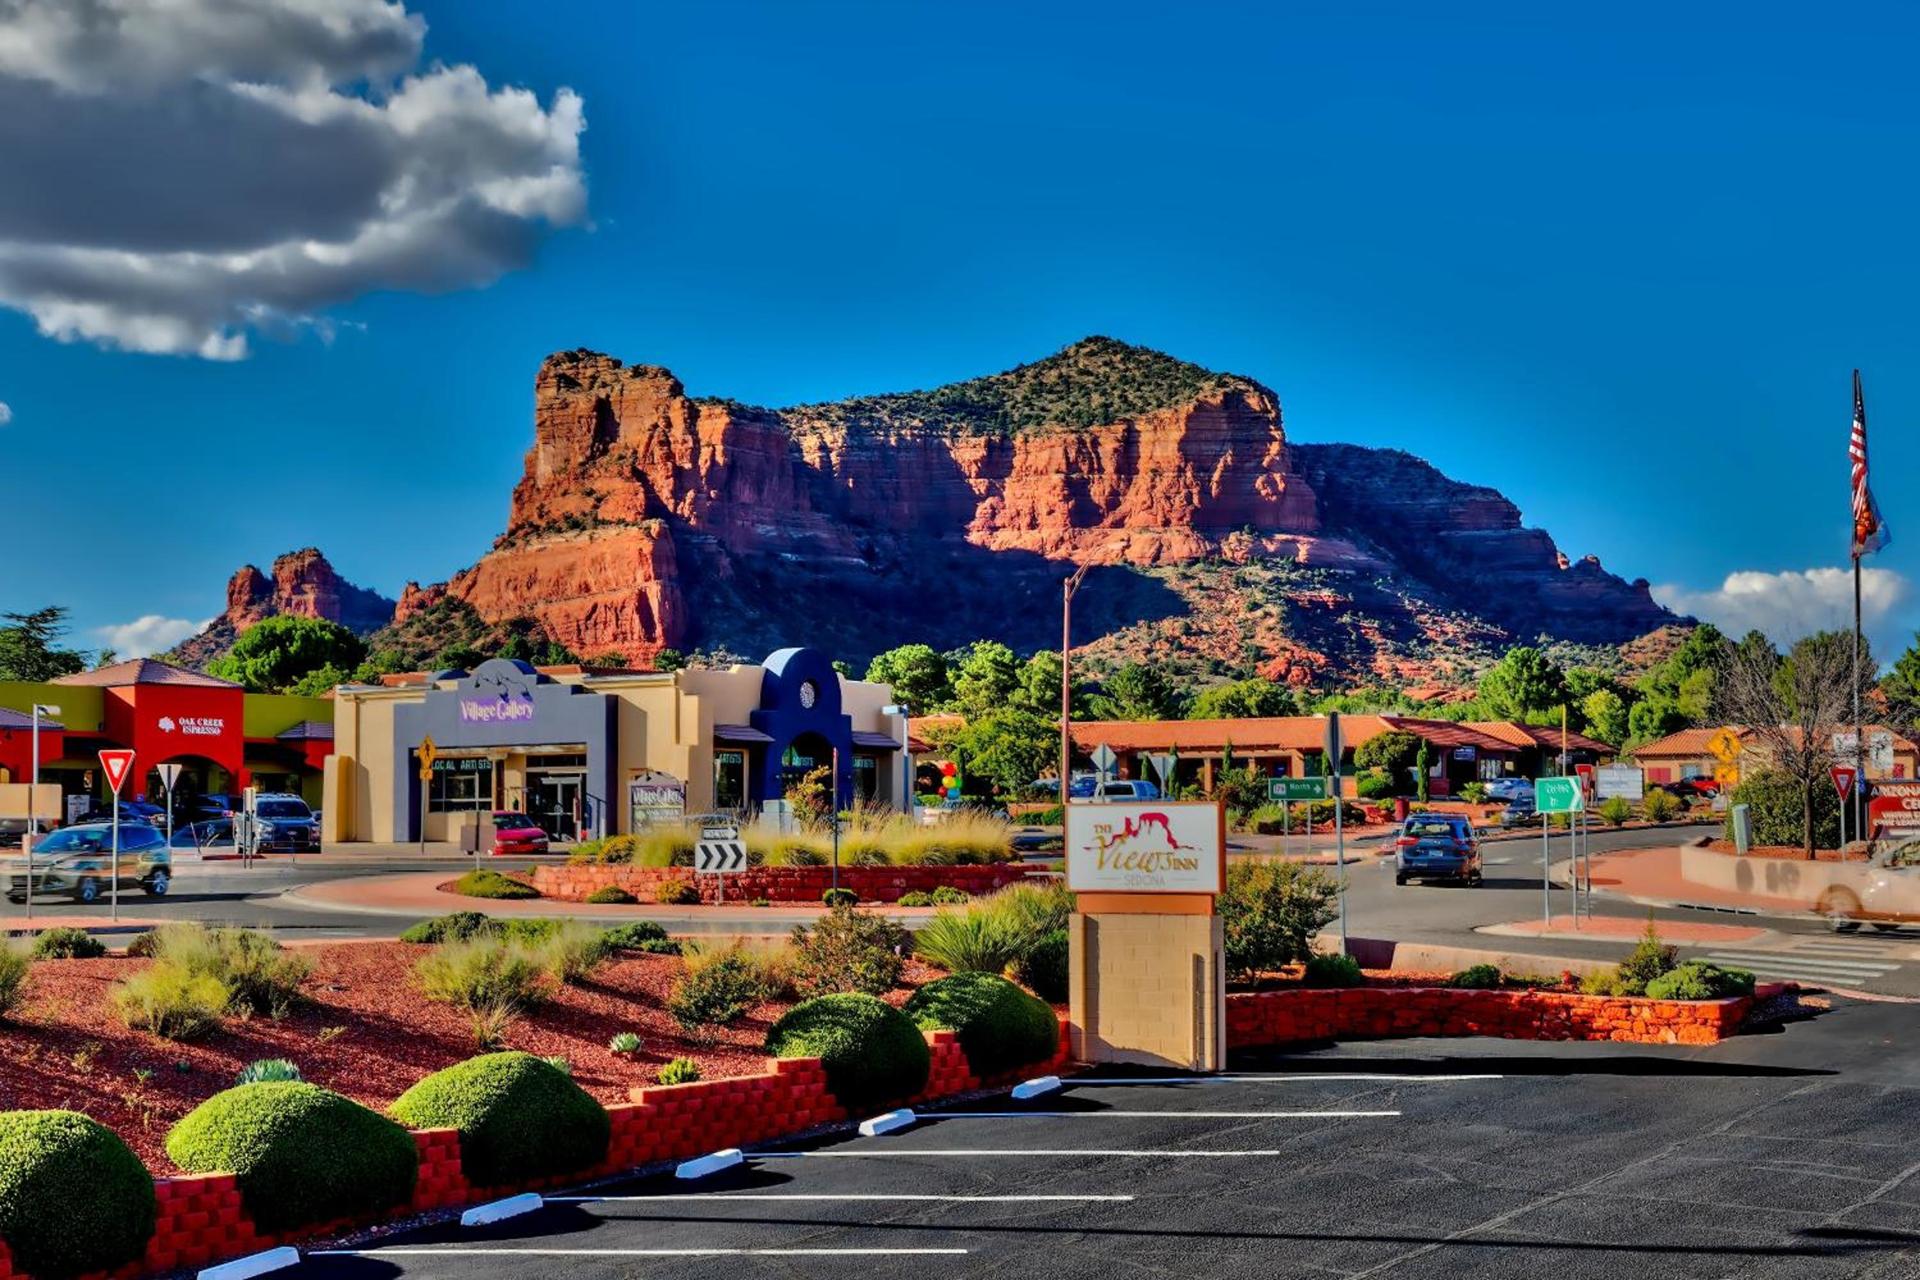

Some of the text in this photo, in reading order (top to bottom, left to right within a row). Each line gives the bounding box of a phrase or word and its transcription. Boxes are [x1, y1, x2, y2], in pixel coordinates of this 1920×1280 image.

[460, 700, 533, 721] Village Gallery
[179, 717, 225, 727] OAK CREEK
[183, 726, 222, 736] ESPRESSO
[433, 760, 456, 770] LOCAL
[461, 760, 492, 770] ARTISTS
[1094, 825, 1112, 834] THE
[1173, 858, 1199, 870] INN
[1124, 874, 1166, 886] SEDONA
